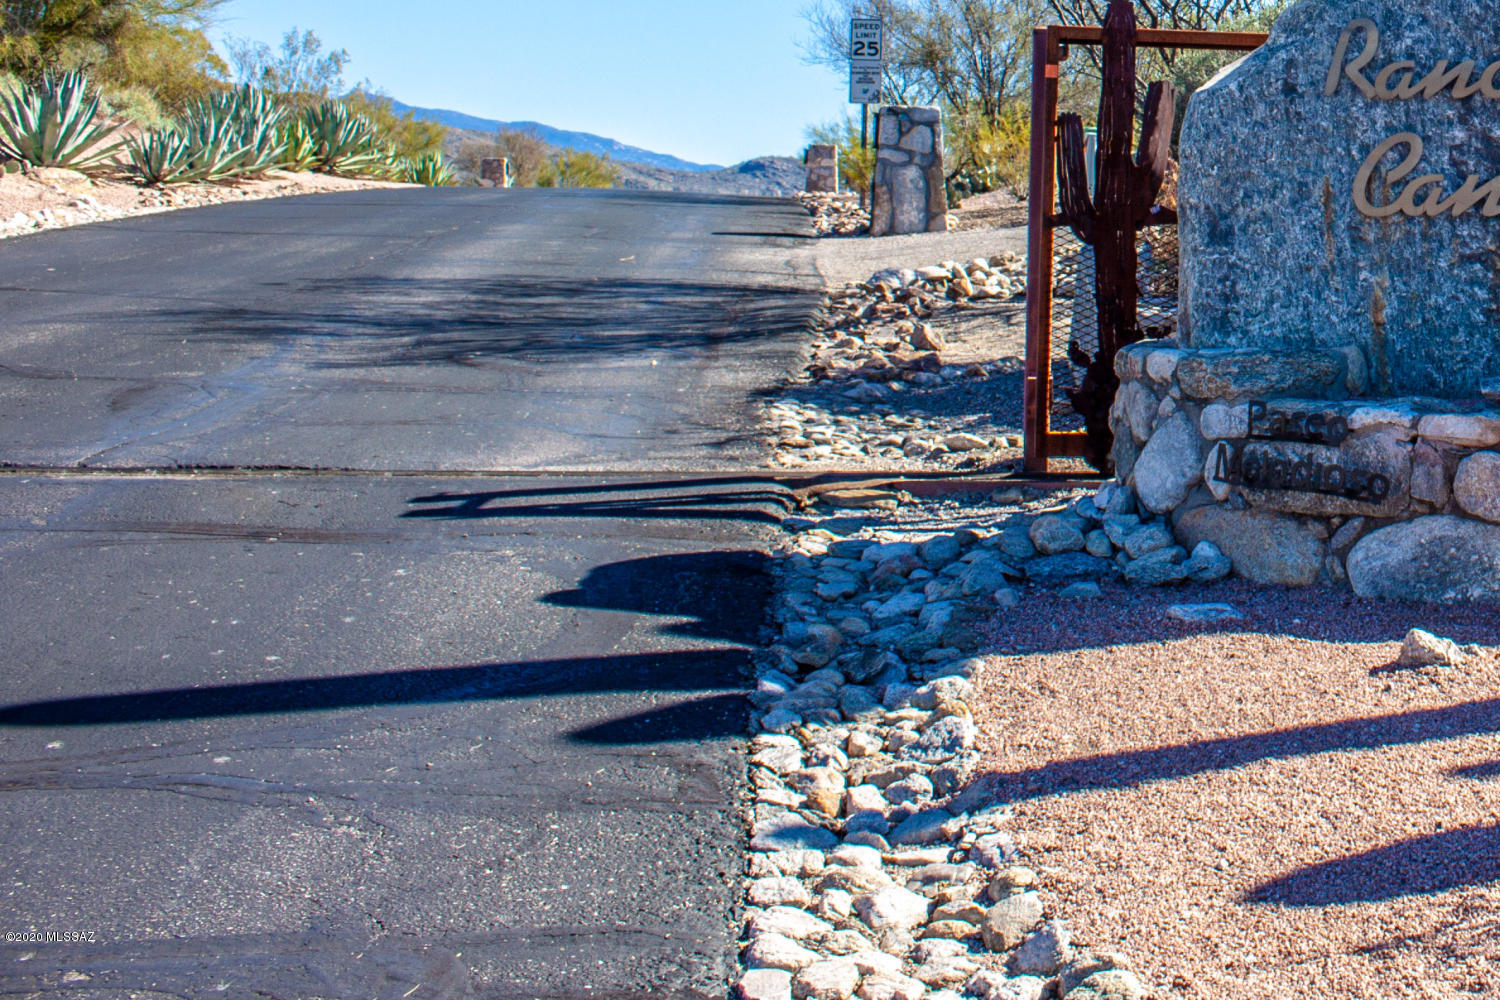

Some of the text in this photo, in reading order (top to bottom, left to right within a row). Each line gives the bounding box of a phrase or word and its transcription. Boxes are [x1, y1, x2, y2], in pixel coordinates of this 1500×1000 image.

[855, 31, 877, 39] LIMIT
[853, 41, 879, 56] 25
[1249, 401, 1349, 444] Paseo
